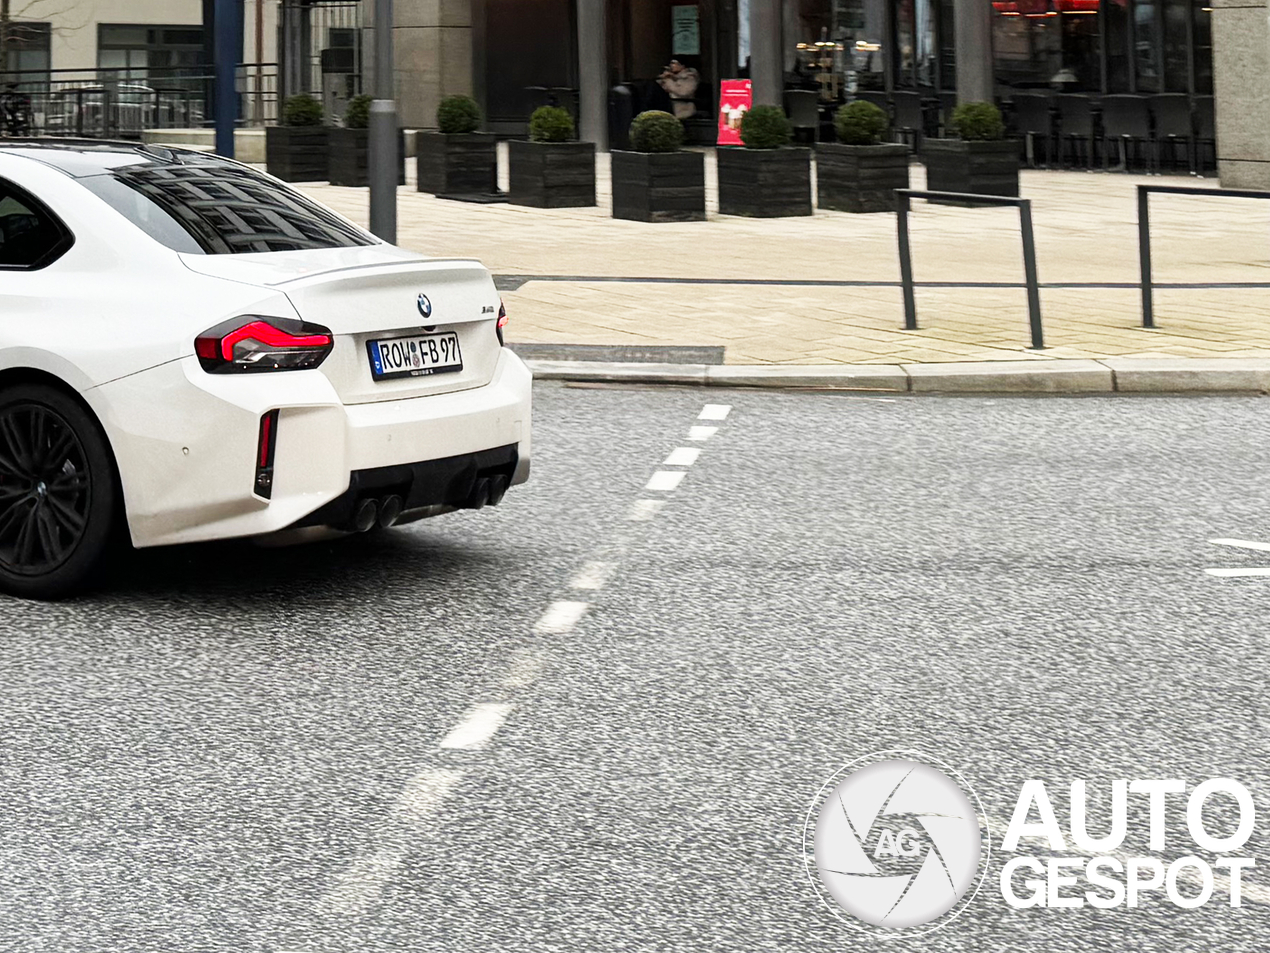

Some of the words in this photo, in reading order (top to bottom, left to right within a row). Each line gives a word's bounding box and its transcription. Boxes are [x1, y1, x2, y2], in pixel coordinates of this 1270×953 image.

[380, 340, 411, 370] ROW
[418, 338, 439, 365] FB
[441, 336, 457, 363] 97
